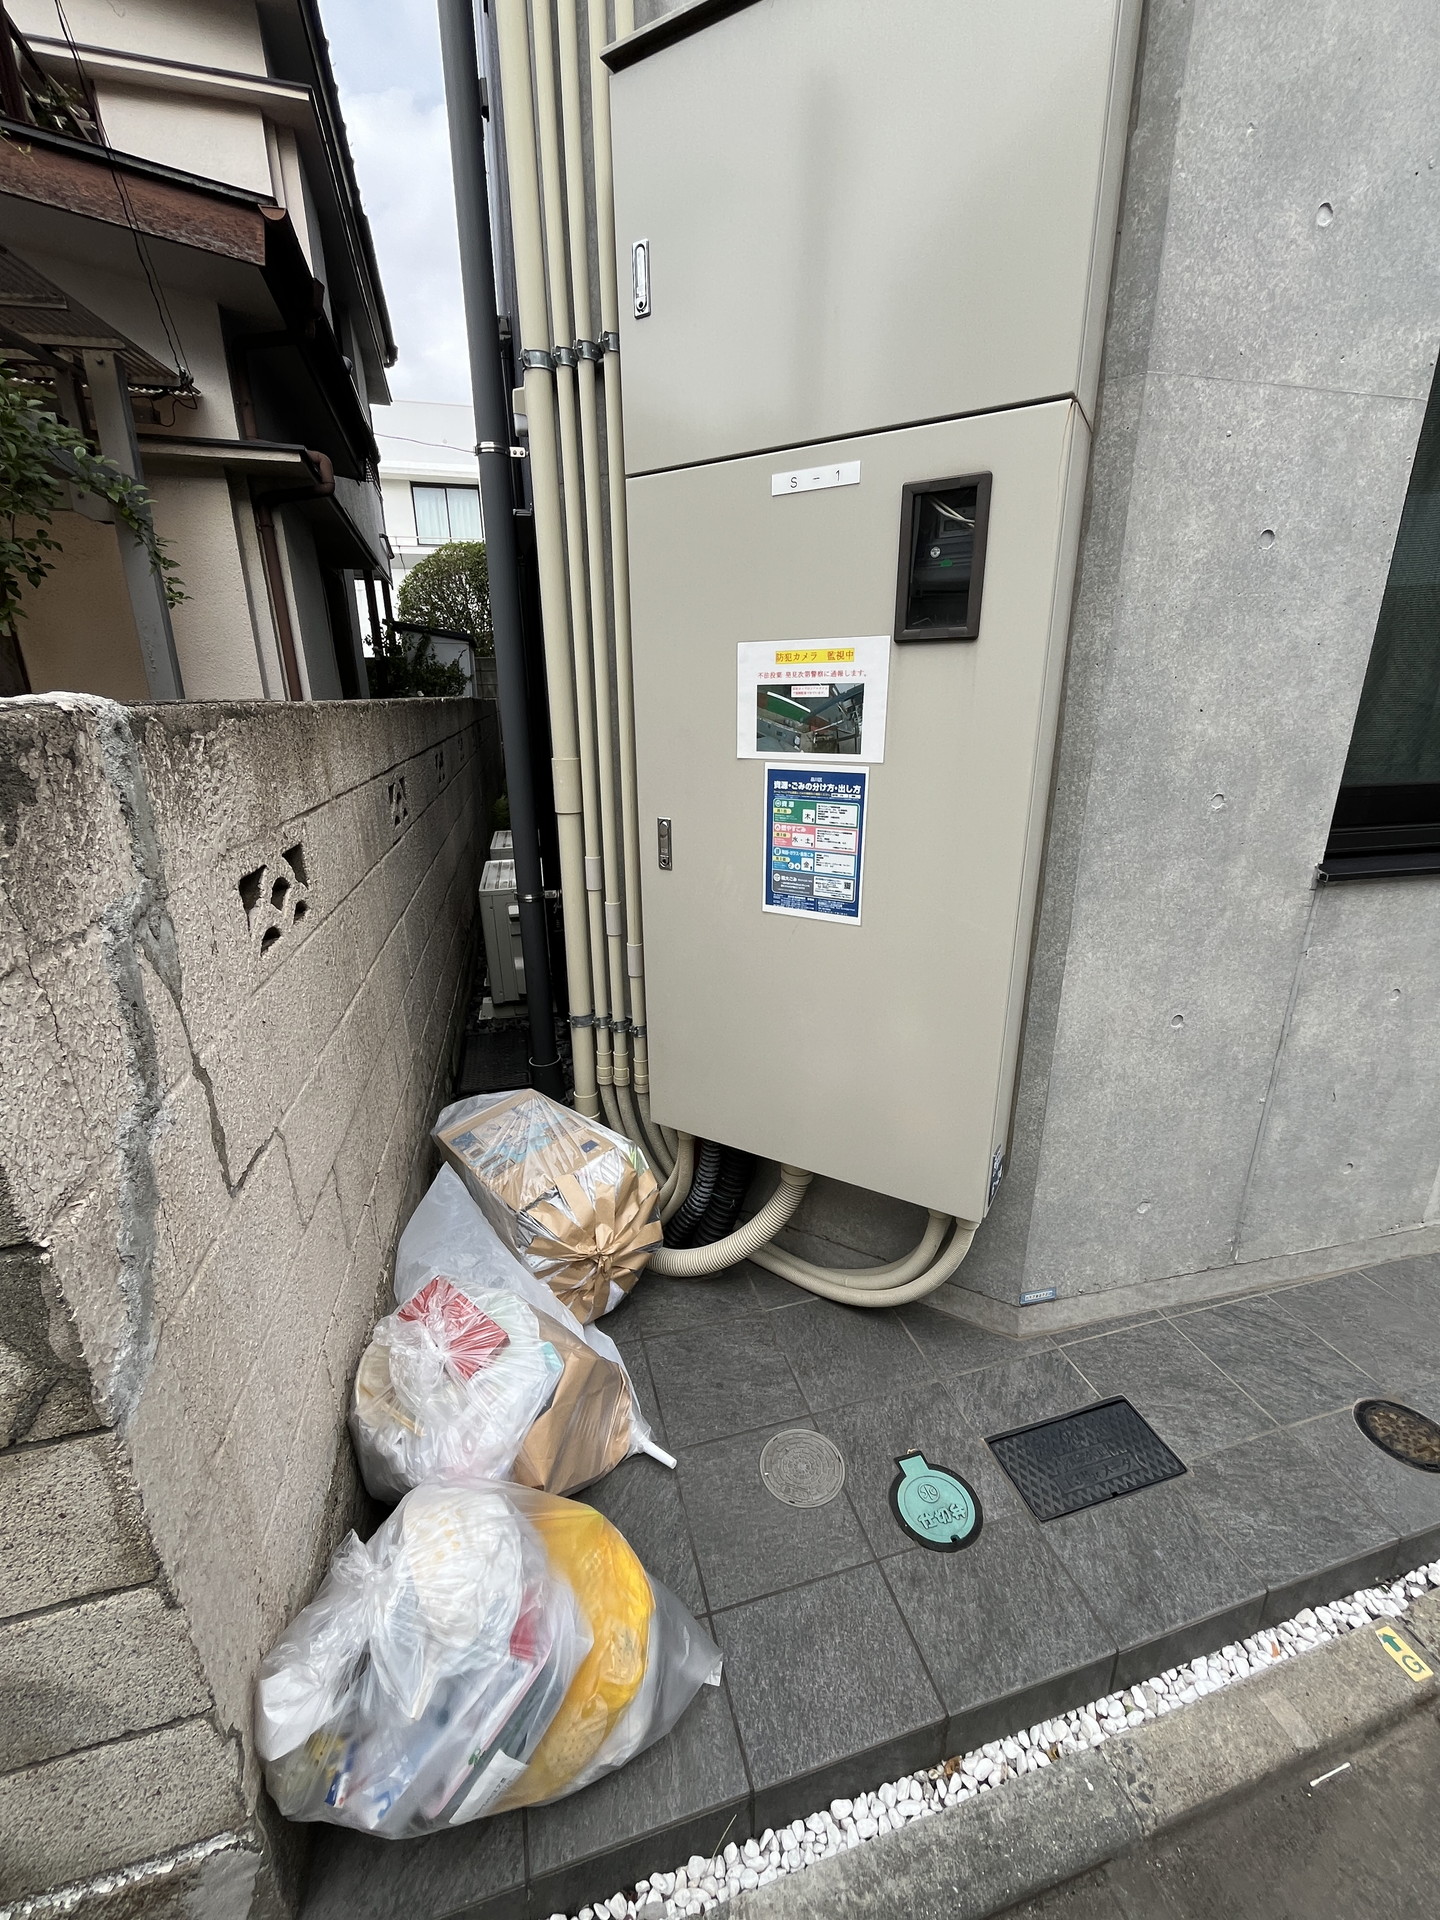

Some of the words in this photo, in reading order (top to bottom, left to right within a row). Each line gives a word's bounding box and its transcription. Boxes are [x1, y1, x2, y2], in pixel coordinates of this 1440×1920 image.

[775, 651, 818, 663] 防犯カメラ
[827, 650, 855, 661] 監視中
